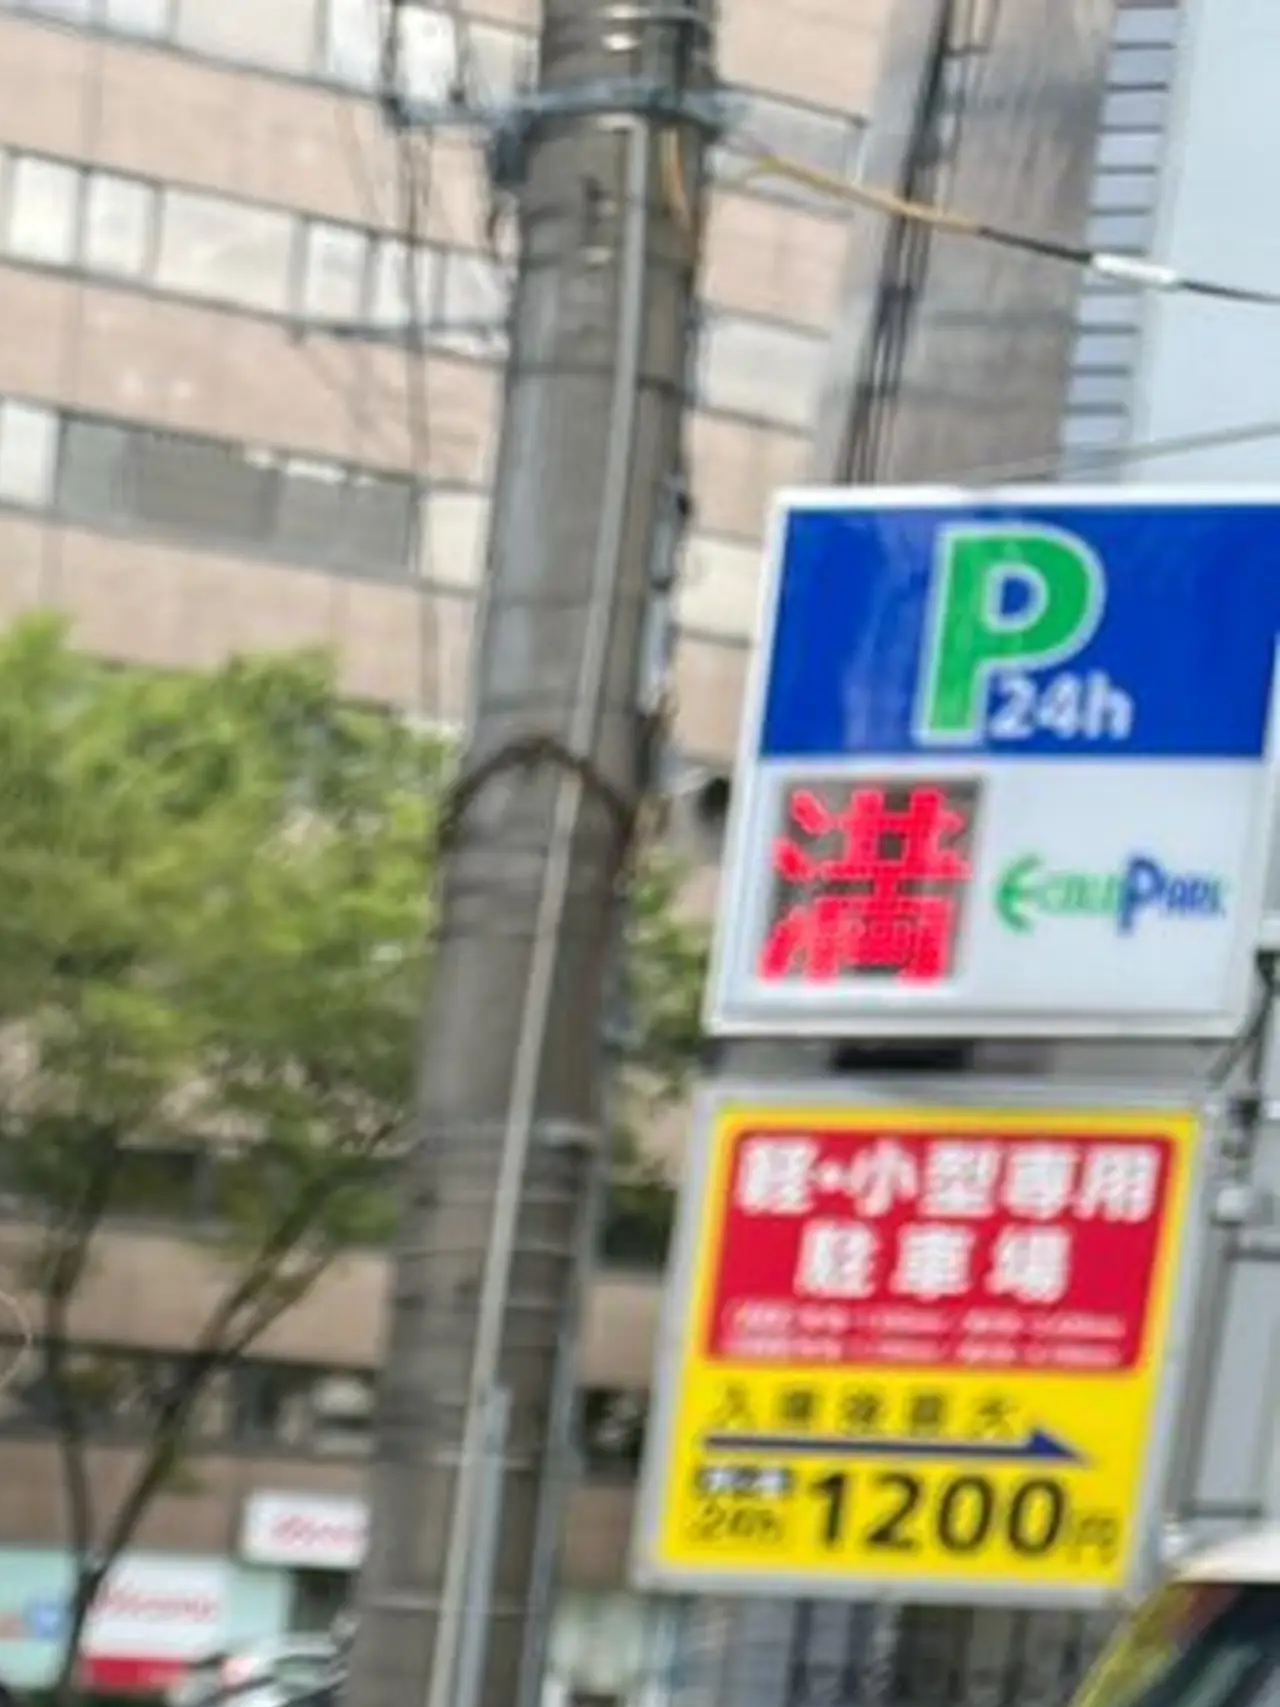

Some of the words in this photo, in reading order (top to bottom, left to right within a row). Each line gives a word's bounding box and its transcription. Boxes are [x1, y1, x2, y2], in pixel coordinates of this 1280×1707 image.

[914, 522, 1104, 744] P
[990, 670, 1133, 740] 24h
[759, 787, 972, 983] 満
[795, 1222, 1070, 1300] 駐車場
